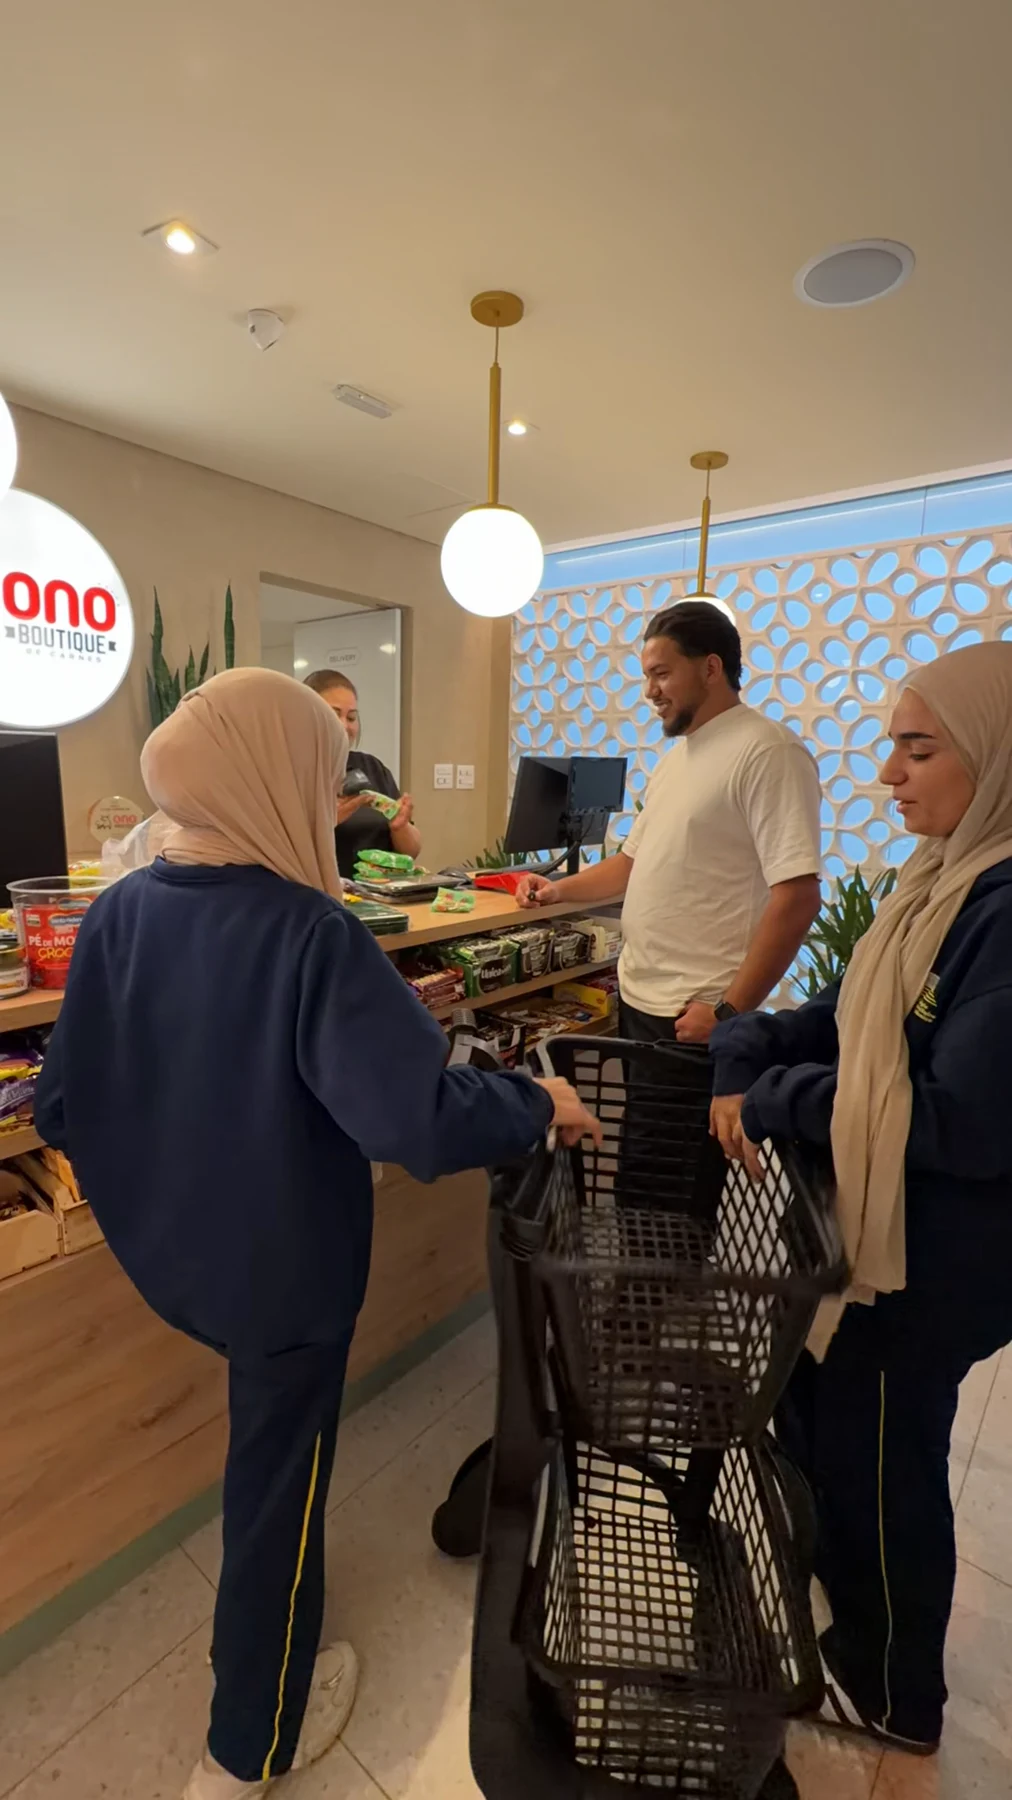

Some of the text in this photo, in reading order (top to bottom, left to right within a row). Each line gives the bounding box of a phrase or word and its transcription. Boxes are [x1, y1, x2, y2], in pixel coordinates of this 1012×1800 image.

[18, 623, 106, 655] BOUTIQUE
[50, 651, 102, 663] CARNES
[28, 933, 42, 946] PÉ
[54, 936, 76, 947] MO
[38, 947, 74, 959] CROC
